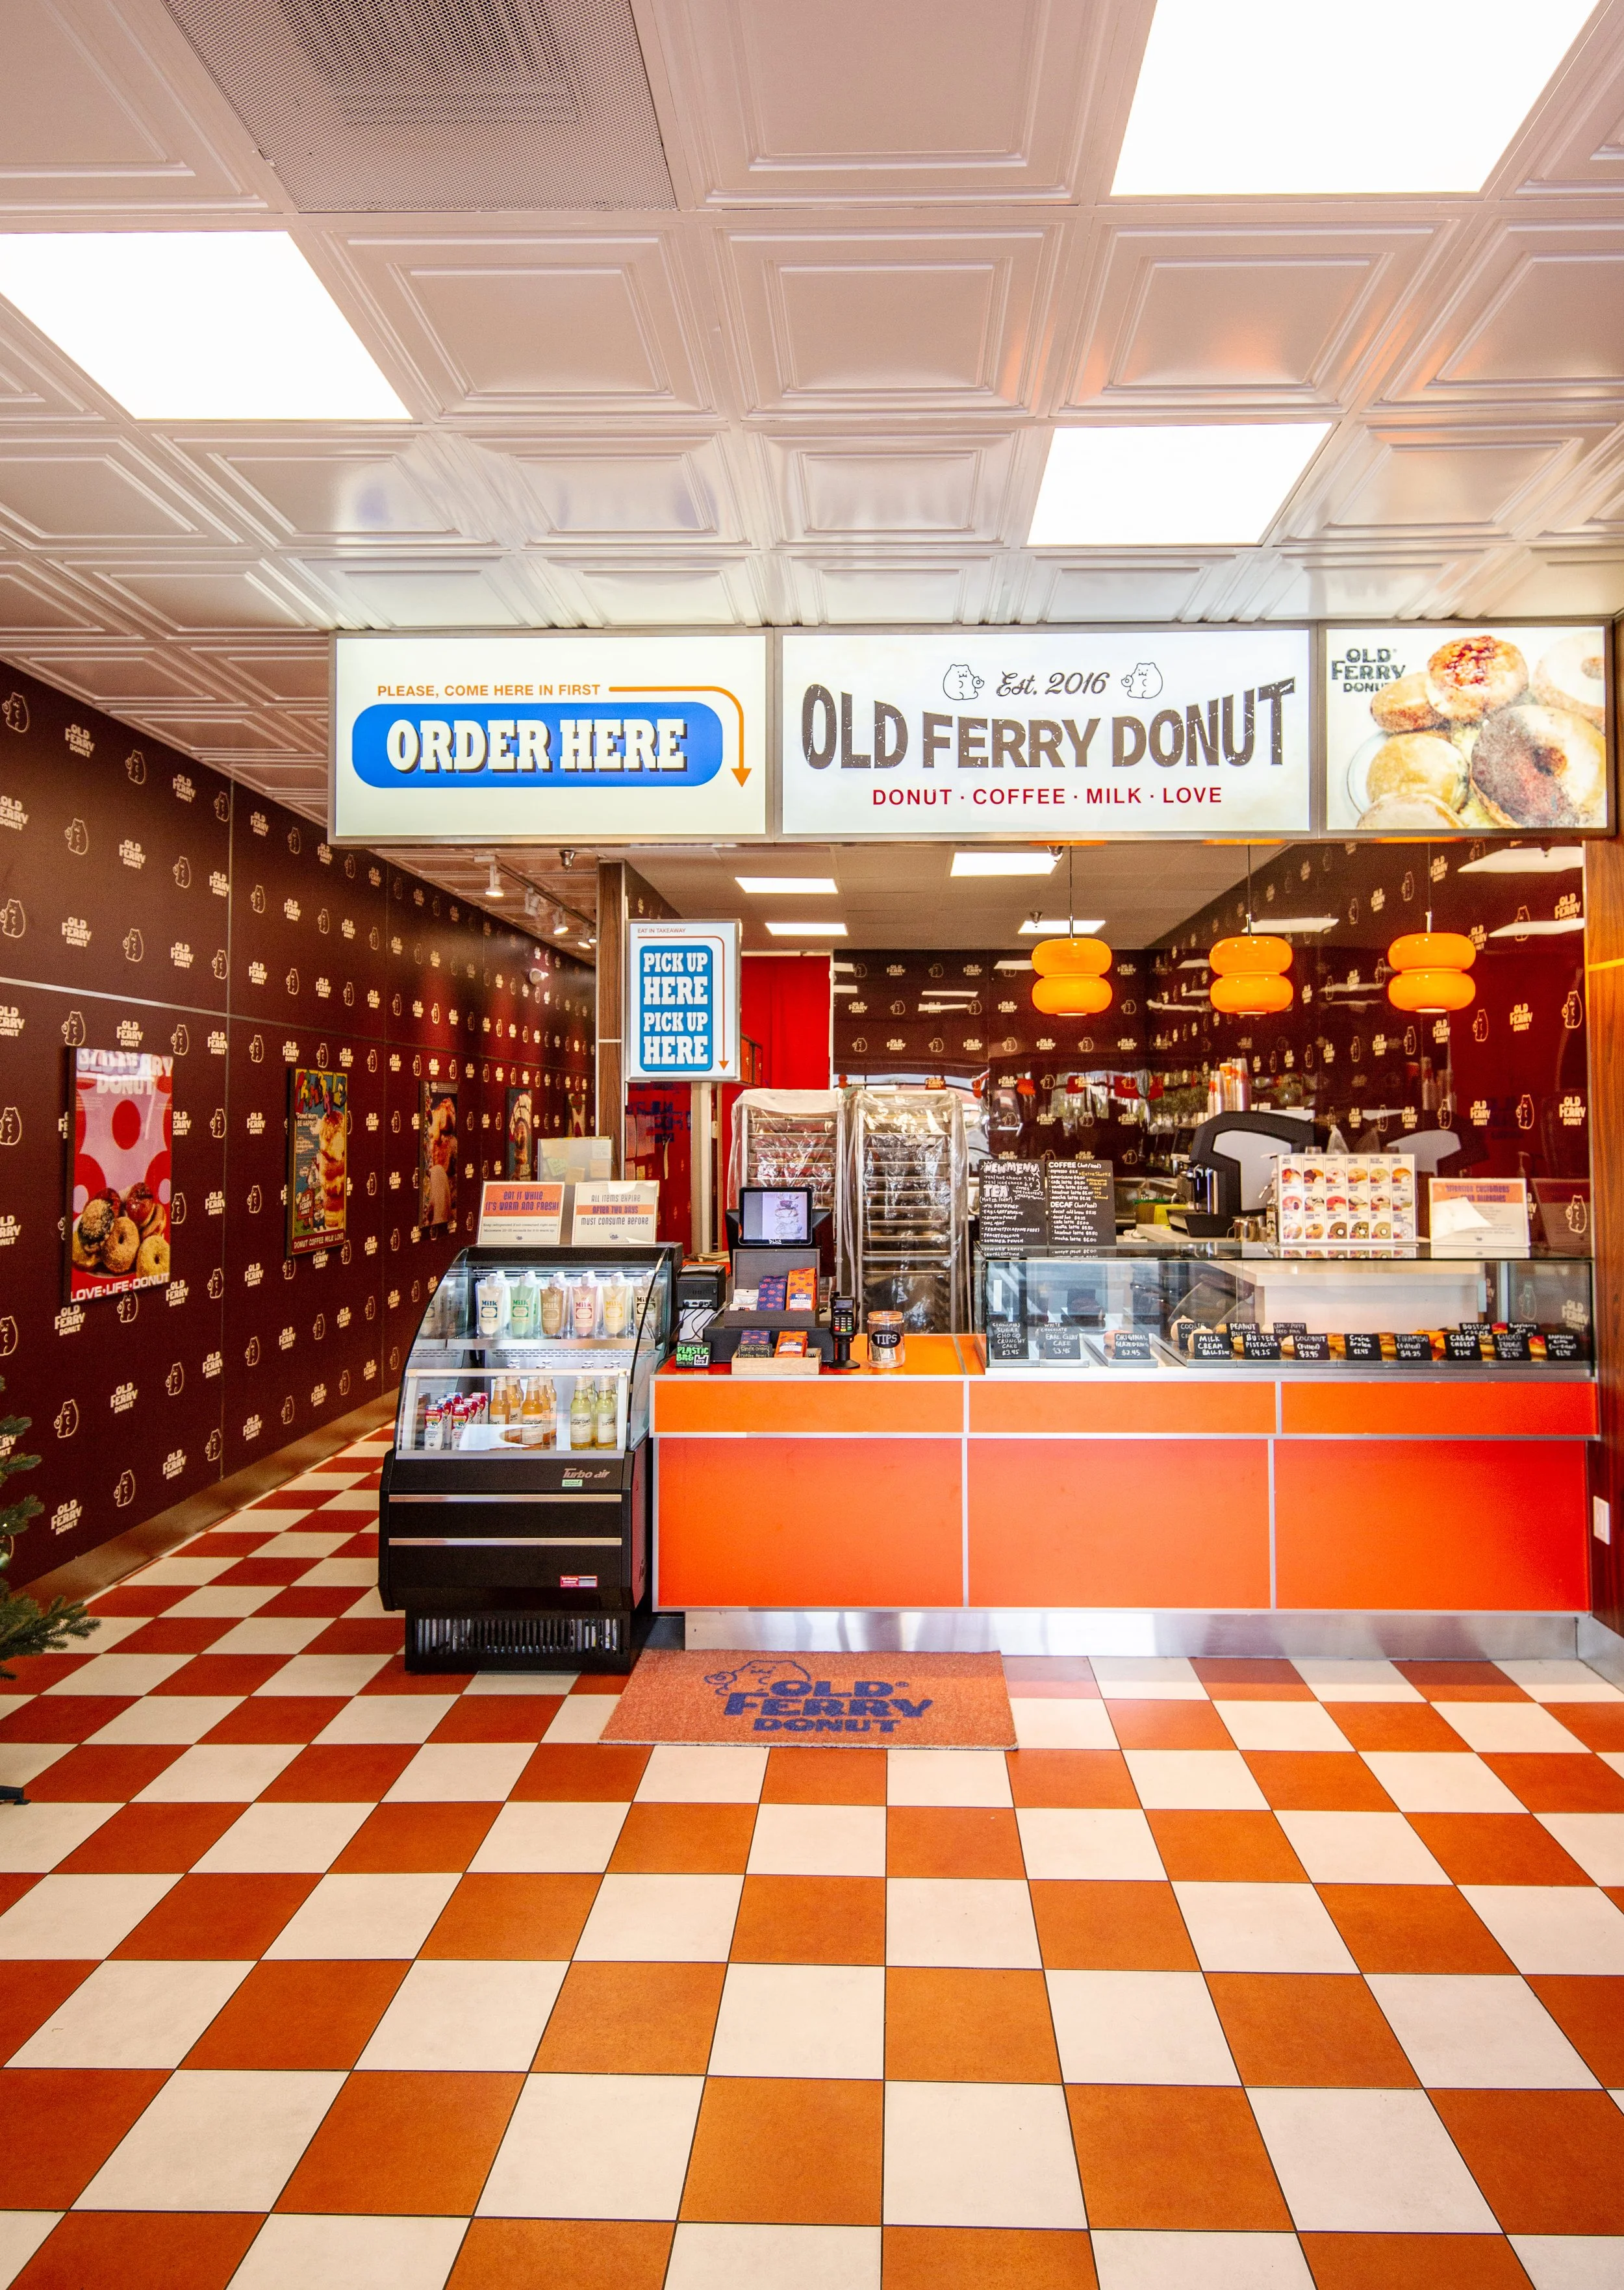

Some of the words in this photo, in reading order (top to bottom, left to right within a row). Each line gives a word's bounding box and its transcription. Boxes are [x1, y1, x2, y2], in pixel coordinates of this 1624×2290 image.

[1346, 648, 1391, 663] OLD
[1332, 660, 1406, 680] FERRY
[377, 684, 439, 699] PLEASE,
[444, 684, 489, 696] COME
[494, 684, 533, 696] HERE
[539, 683, 553, 696] IN
[558, 683, 601, 696] FIRST
[996, 670, 1037, 697] Est.
[1045, 672, 1110, 695] 2016
[802, 683, 909, 770] OLD
[922, 711, 1102, 769] FERRY
[1111, 676, 1296, 768] DONUT
[387, 719, 552, 773] ORDER
[559, 718, 689, 773] HERE
[872, 789, 952, 806] DONUT
[972, 788, 1066, 805] COFFEE
[1086, 787, 1142, 804] MILK
[1163, 787, 1222, 804] LOVE
[643, 952, 683, 973] PICK
[687, 952, 708, 973] UP
[643, 976, 708, 1004] HERE
[643, 1012, 683, 1032] PICK
[687, 1012, 708, 1032] UP
[643, 1036, 708, 1064] HERE
[983, 1162, 1006, 1175] NEW
[1006, 1161, 1039, 1175] MENU
[525, 1191, 543, 1200] WHILE
[983, 1184, 1009, 1198] TEA
[499, 1202, 519, 1210] WARM
[521, 1202, 534, 1210] AND
[598, 1217, 625, 1225] CONSUME
[628, 1217, 648, 1225] BEFORE
[874, 1334, 897, 1345] TIPS
[563, 1468, 593, 1479] Turbo
[593, 1469, 610, 1478] air
[769, 1680, 895, 1698] OLD
[723, 1692, 933, 1718] FERRY
[752, 1717, 902, 1733] DONUT
